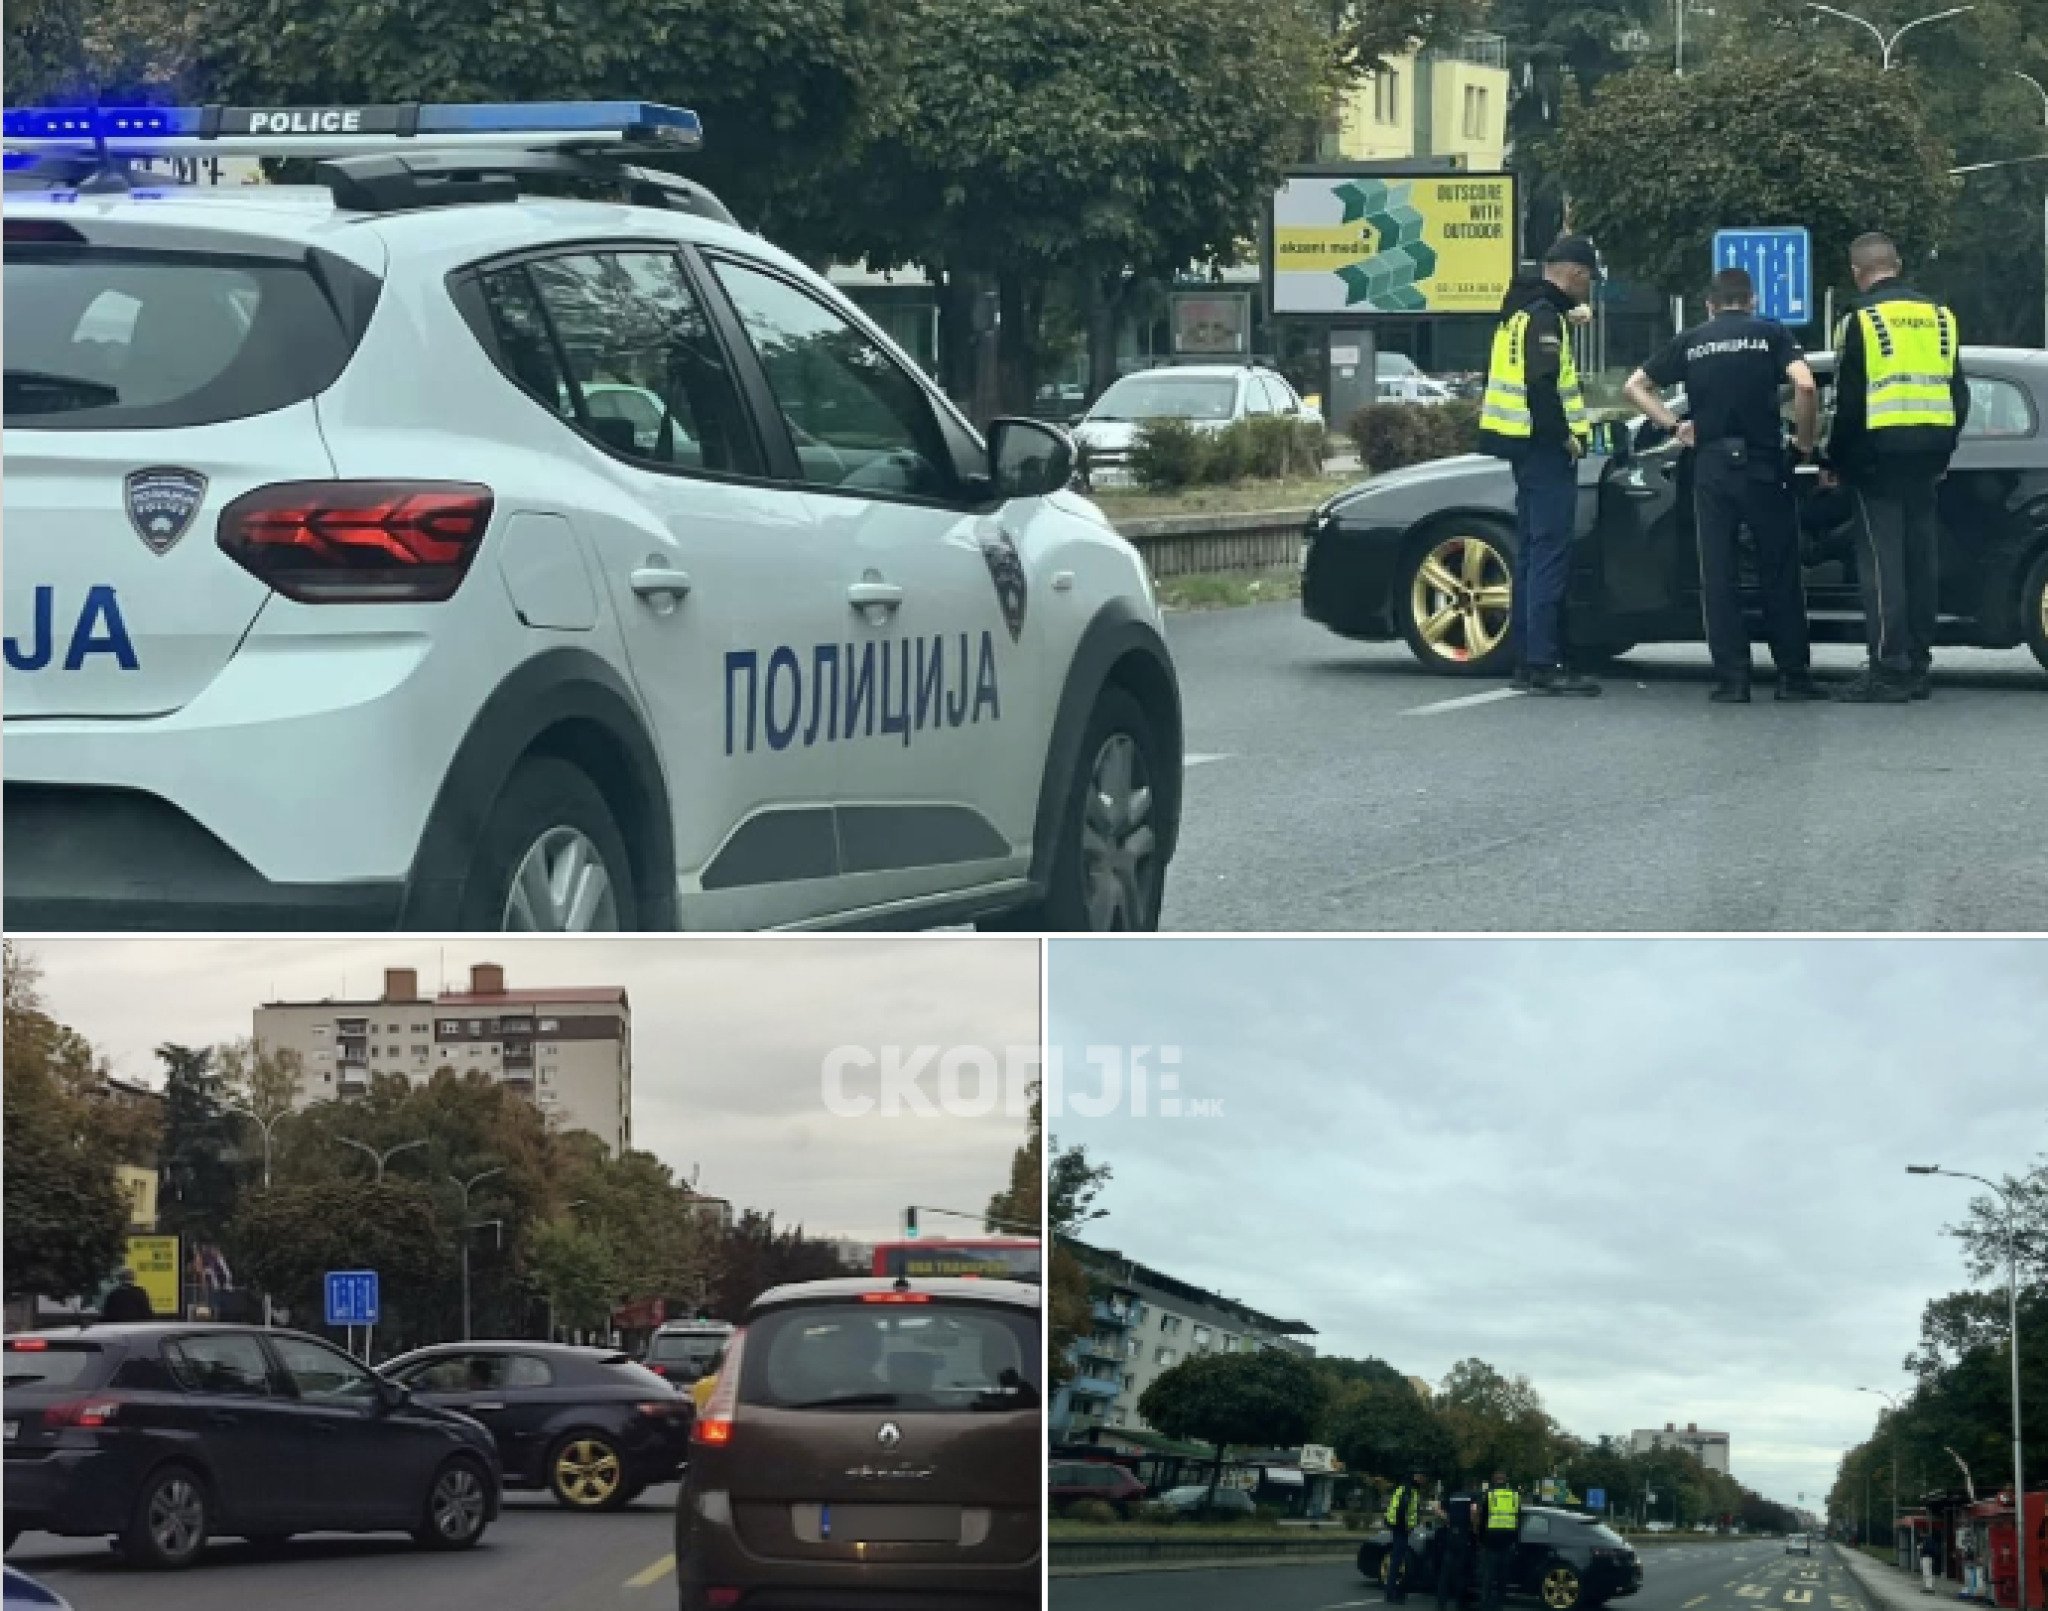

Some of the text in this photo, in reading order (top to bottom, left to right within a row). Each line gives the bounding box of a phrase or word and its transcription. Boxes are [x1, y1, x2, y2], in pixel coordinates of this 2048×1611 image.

[250, 110, 361, 131] POLICE
[1437, 184, 1503, 202] OUTSCORE
[1470, 204, 1503, 220] WITH
[1443, 223, 1503, 238] OUTDOOR
[724, 631, 1000, 756] ПОЛИЦИЈА
